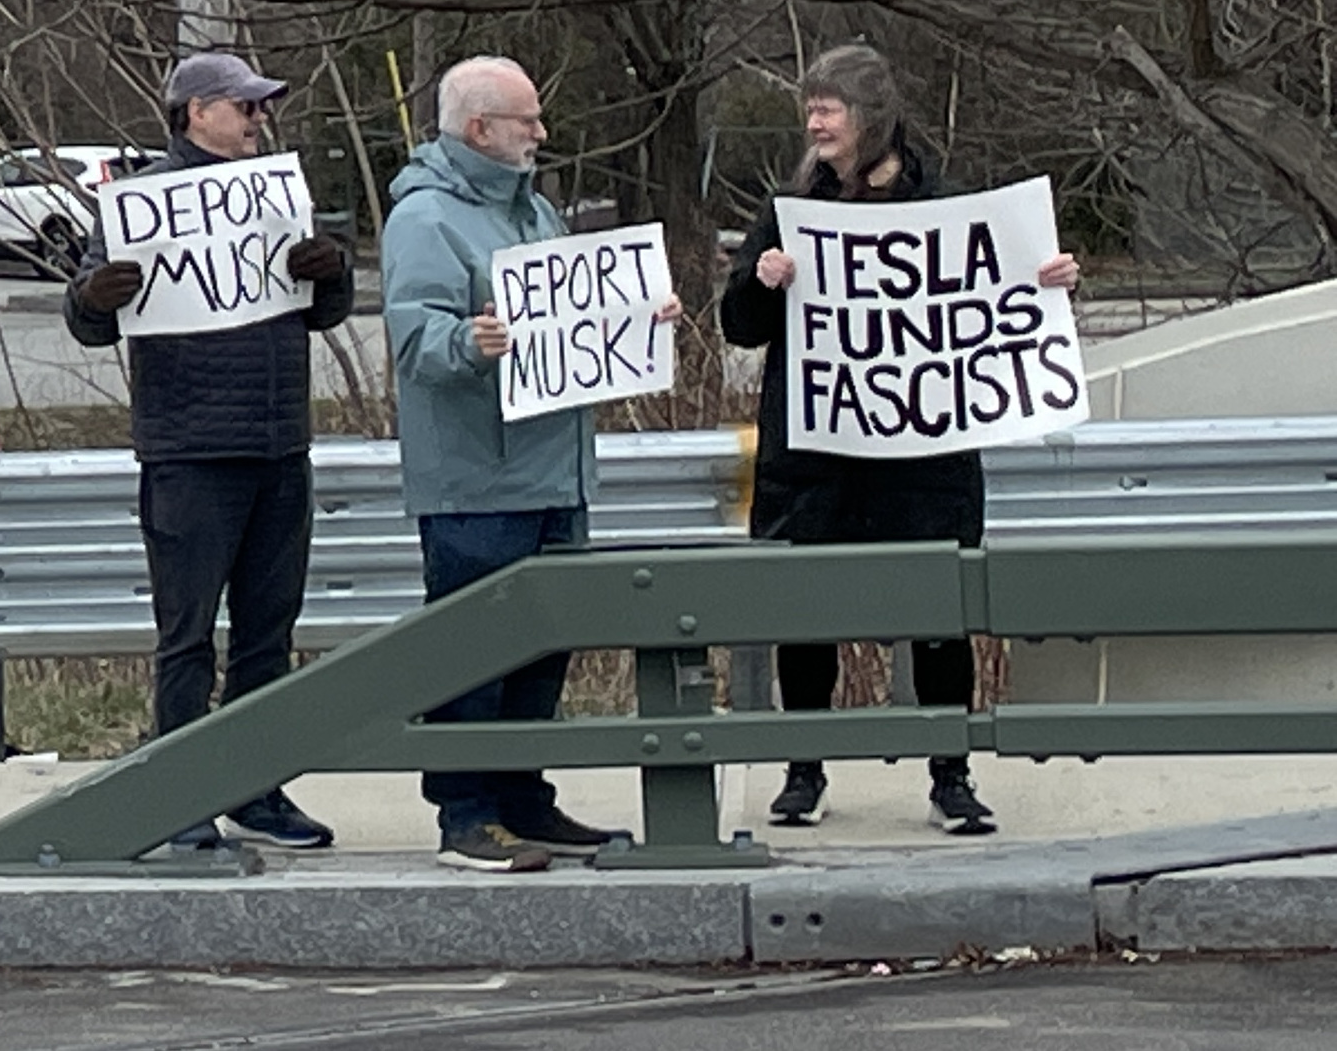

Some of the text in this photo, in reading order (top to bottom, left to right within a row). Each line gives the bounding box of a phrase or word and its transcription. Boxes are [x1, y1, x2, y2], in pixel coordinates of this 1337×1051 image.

[116, 170, 295, 245] DEPORT
[502, 242, 654, 325] DEPORT
[797, 222, 1001, 300] TESLA
[508, 313, 658, 406] MUSK!
[804, 284, 1044, 361] FUNDS
[802, 334, 1078, 437] FASCISTS
